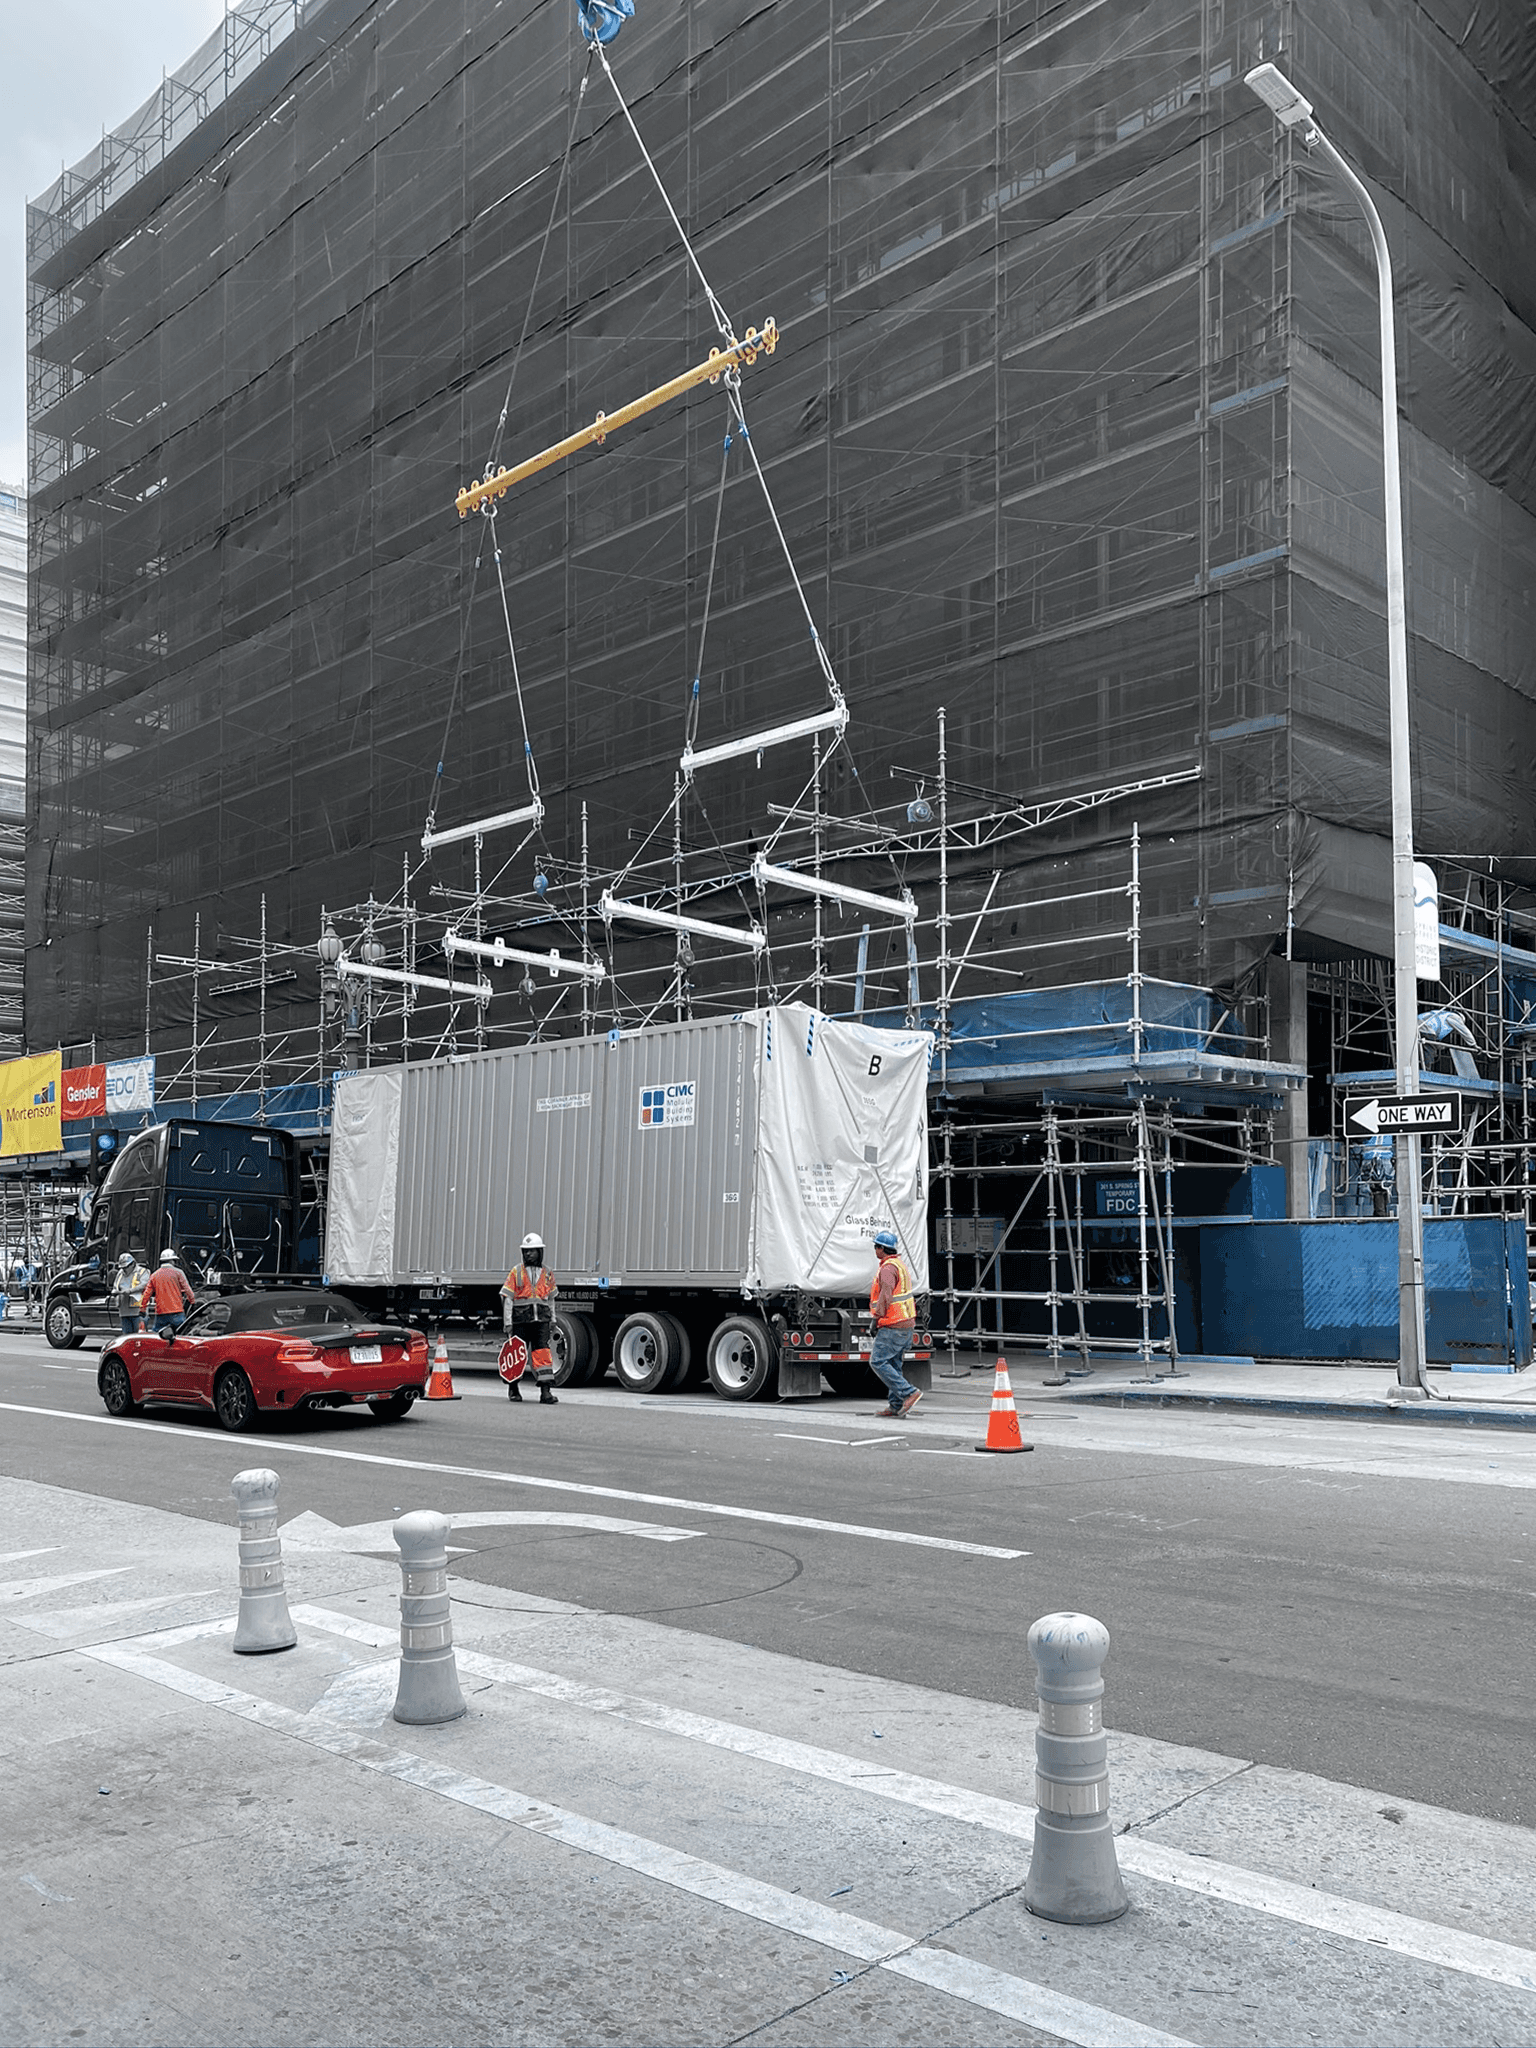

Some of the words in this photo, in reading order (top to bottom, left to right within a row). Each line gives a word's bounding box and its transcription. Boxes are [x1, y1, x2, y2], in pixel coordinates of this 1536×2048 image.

[868, 1054, 882, 1076] B
[66, 1083, 100, 1103] Gensler
[667, 1084, 694, 1097] CIMC
[666, 1098, 693, 1106] Modular
[6, 1104, 57, 1122] Mortenson
[666, 1107, 693, 1115] Building
[1378, 1107, 1409, 1123] ONE
[1414, 1105, 1447, 1121] WAY
[666, 1115, 693, 1125] Systems
[1105, 1190, 1136, 1198] TEMPORARY
[1106, 1198, 1136, 1212] FDC
[845, 1215, 869, 1226] Glass
[869, 1216, 891, 1229] Behind
[501, 1346, 526, 1373] STOP
